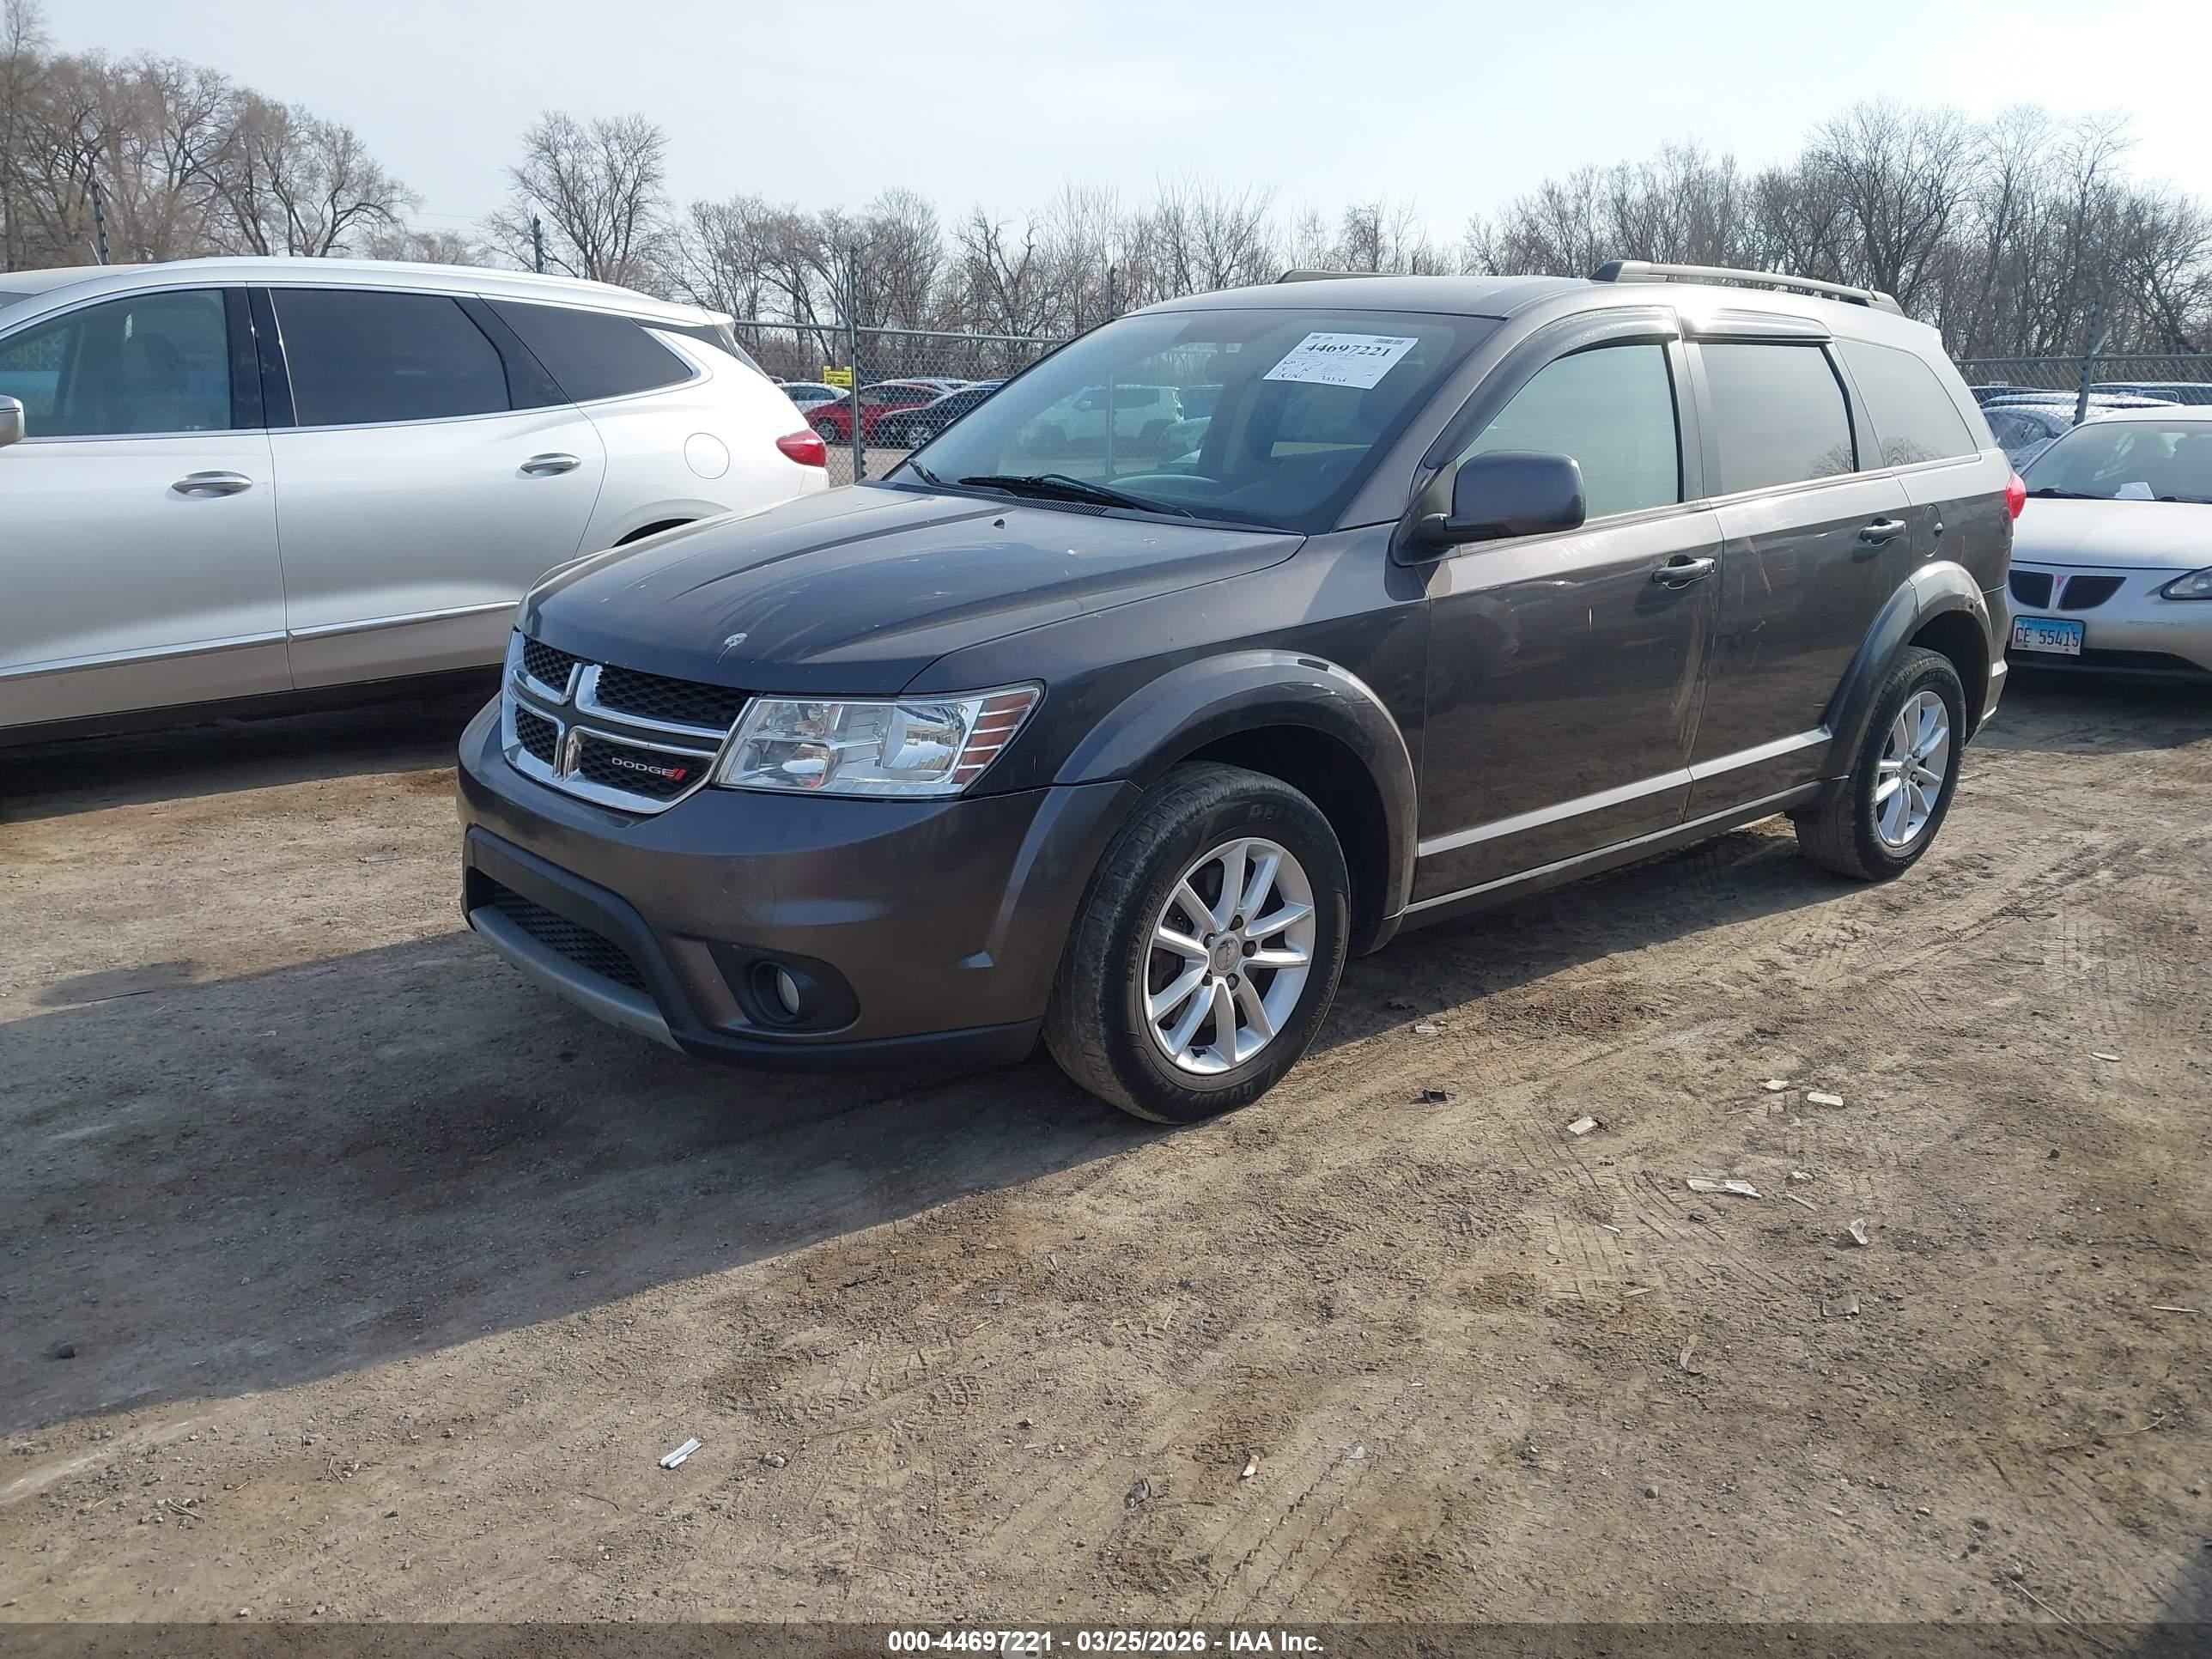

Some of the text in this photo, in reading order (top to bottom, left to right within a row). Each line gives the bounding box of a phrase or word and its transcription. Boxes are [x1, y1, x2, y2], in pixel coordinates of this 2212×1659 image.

[1306, 343, 1391, 356] 44697221
[2015, 627, 2081, 647] CE 55415
[611, 757, 674, 776] DODGE
